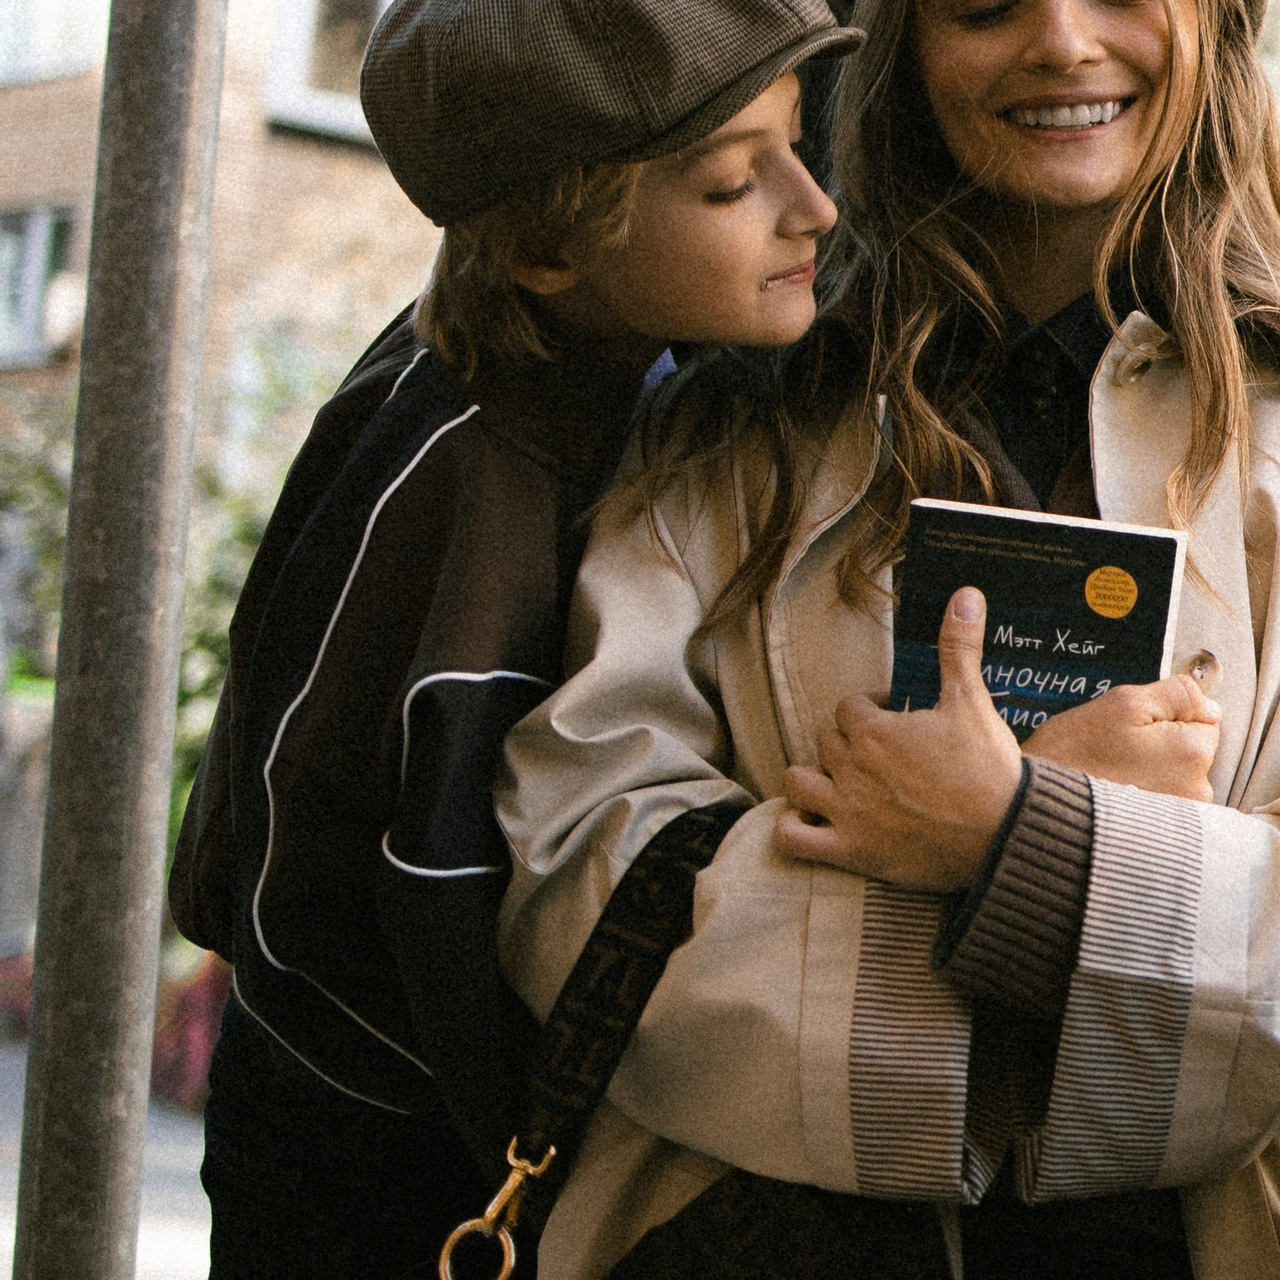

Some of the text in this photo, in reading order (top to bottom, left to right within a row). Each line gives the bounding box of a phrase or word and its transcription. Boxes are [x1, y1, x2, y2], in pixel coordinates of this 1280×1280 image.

[993, 625, 1105, 655] Мэтт Хейг
[981, 664, 1111, 699] лночная
